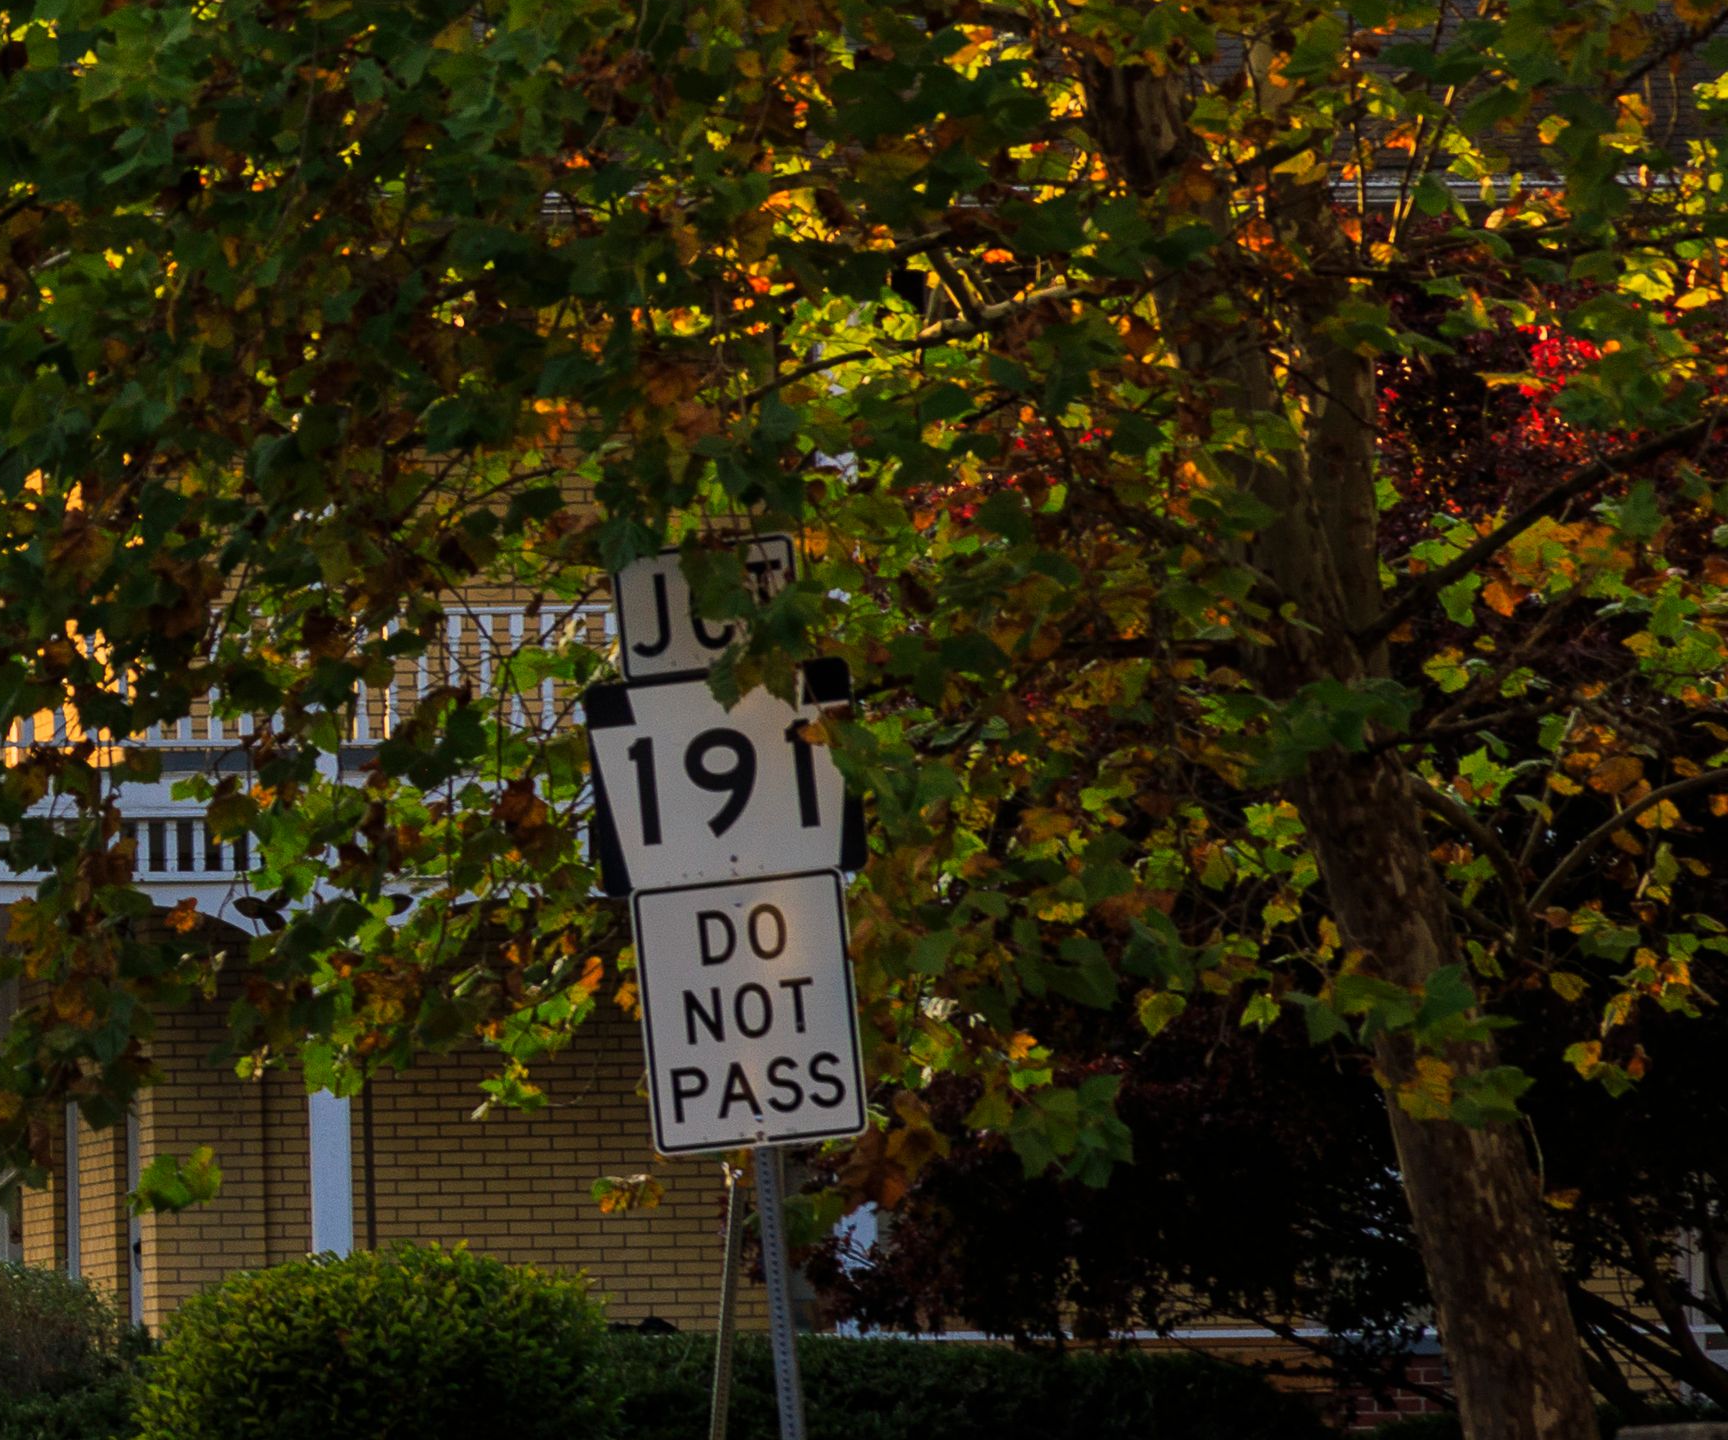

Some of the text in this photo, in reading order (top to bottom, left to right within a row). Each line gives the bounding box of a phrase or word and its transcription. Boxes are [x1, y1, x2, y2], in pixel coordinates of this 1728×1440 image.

[627, 718, 822, 846] 191
[699, 904, 787, 966] DO
[683, 977, 814, 1045] NOT
[669, 1052, 846, 1123] PASS
